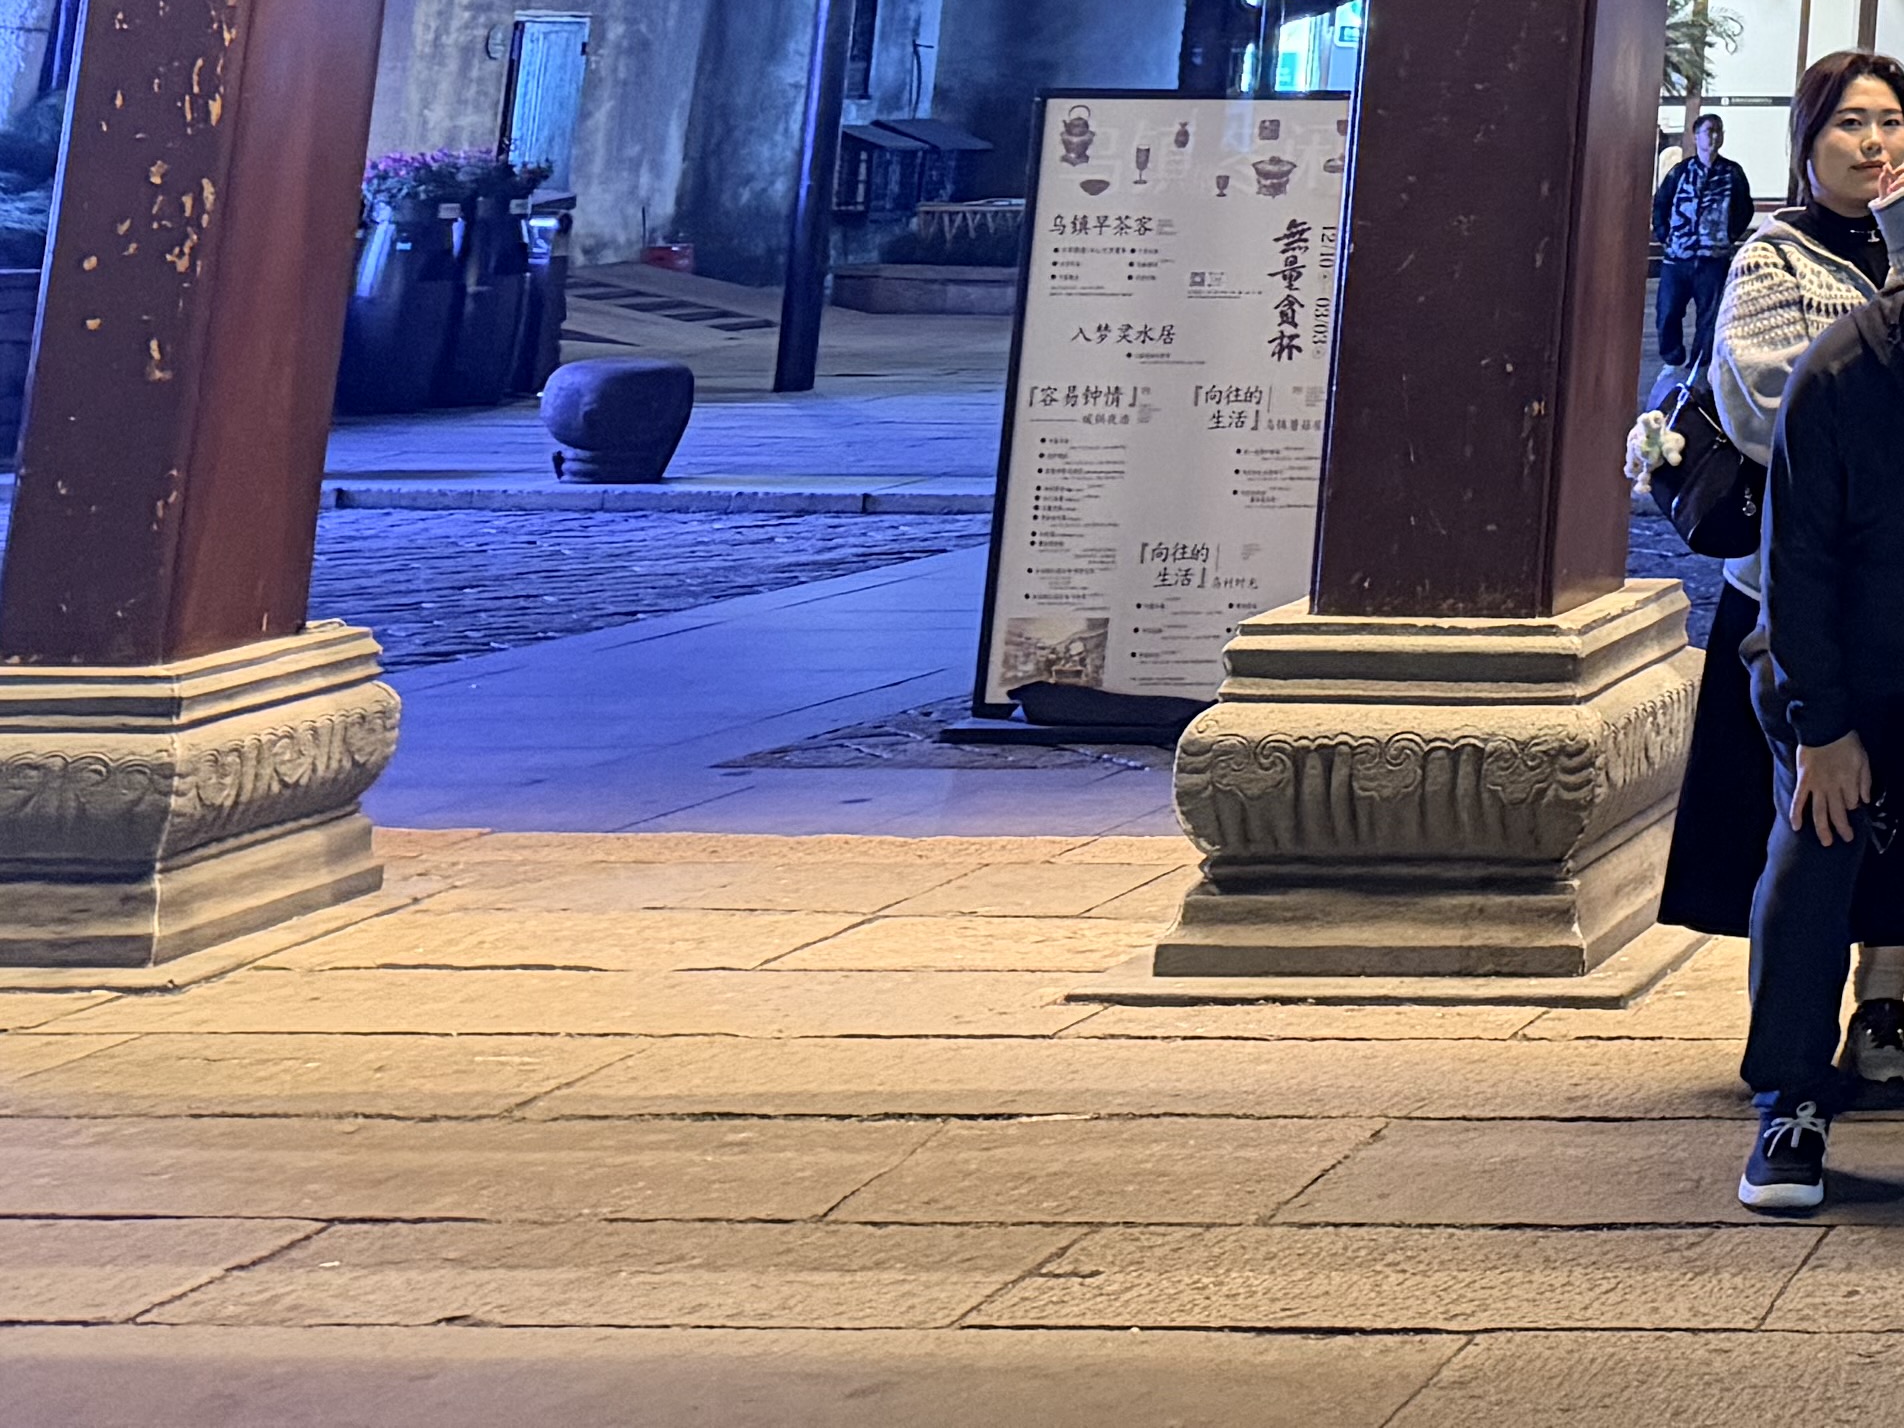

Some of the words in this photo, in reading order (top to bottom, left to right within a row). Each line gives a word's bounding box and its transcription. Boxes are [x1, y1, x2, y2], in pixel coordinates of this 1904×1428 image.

[1049, 214, 1154, 236] 乌镇早茶客
[1319, 226, 1338, 269] 12/10
[1312, 297, 1331, 345] 03/03
